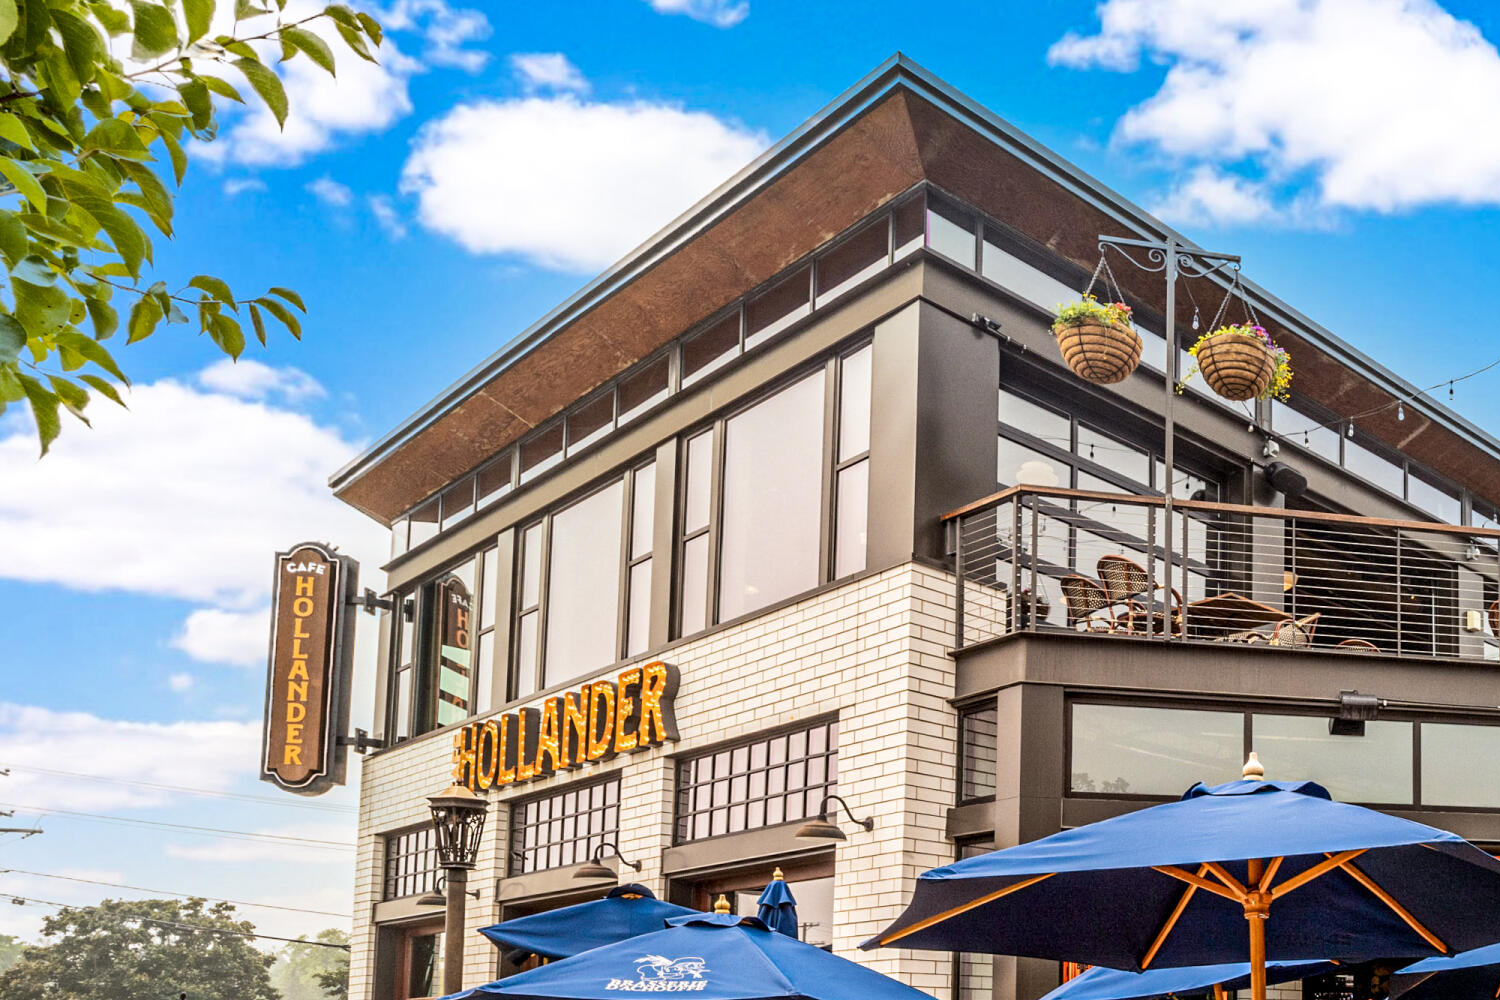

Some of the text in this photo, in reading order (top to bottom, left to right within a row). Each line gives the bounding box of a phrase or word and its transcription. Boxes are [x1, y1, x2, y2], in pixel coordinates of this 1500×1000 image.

[286, 562, 326, 575] CAFE
[283, 576, 315, 765] HOLLANDER
[458, 660, 669, 791] HOLLANDER
